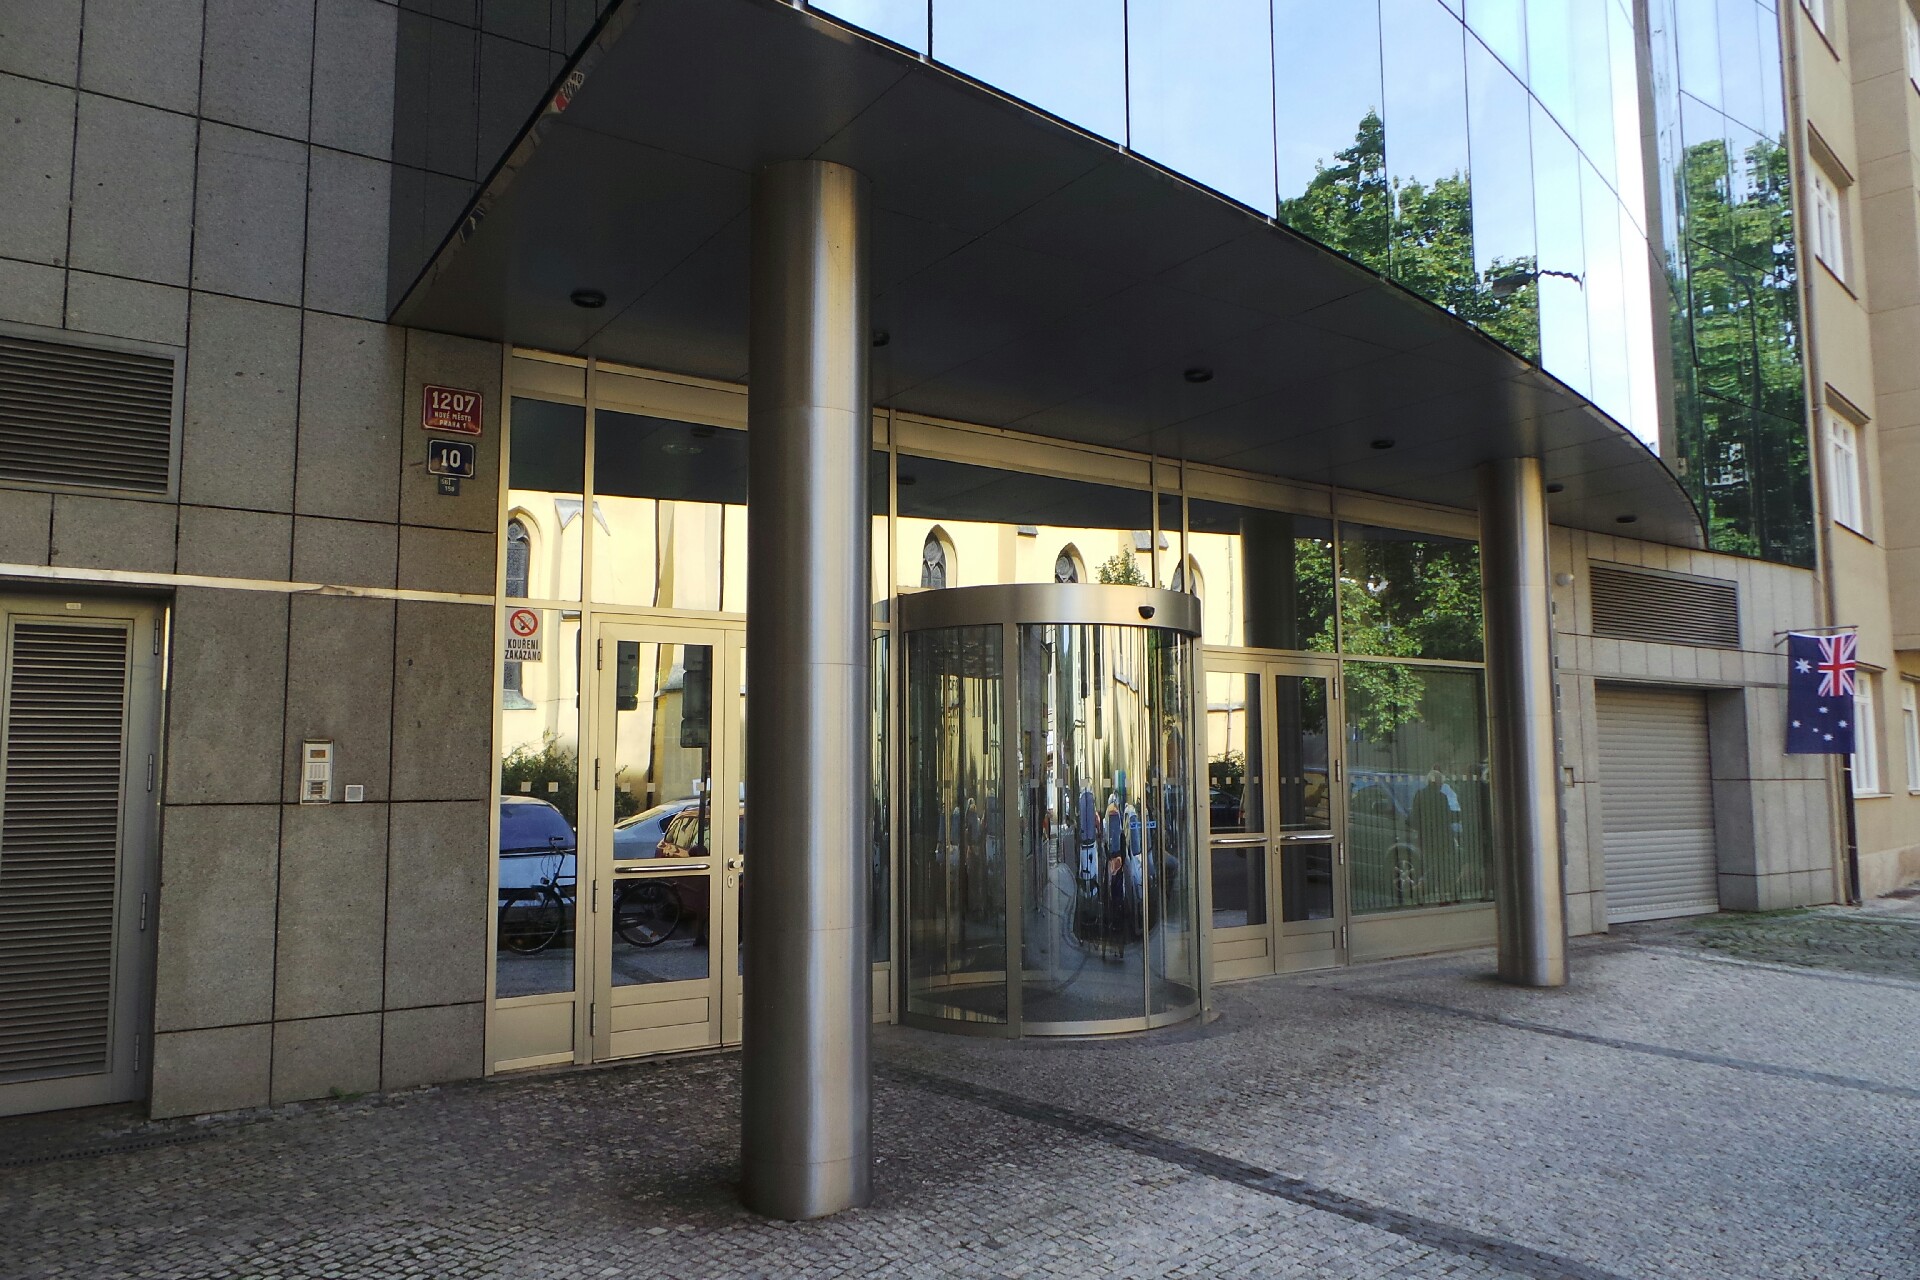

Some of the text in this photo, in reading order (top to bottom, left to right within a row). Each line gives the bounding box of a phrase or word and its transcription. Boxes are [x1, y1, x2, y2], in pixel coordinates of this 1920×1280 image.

[432, 391, 475, 412] 1207
[434, 411, 471, 421] NOVÉ MĚSTO
[439, 419, 460, 428] PRAHA
[441, 448, 461, 467] 10
